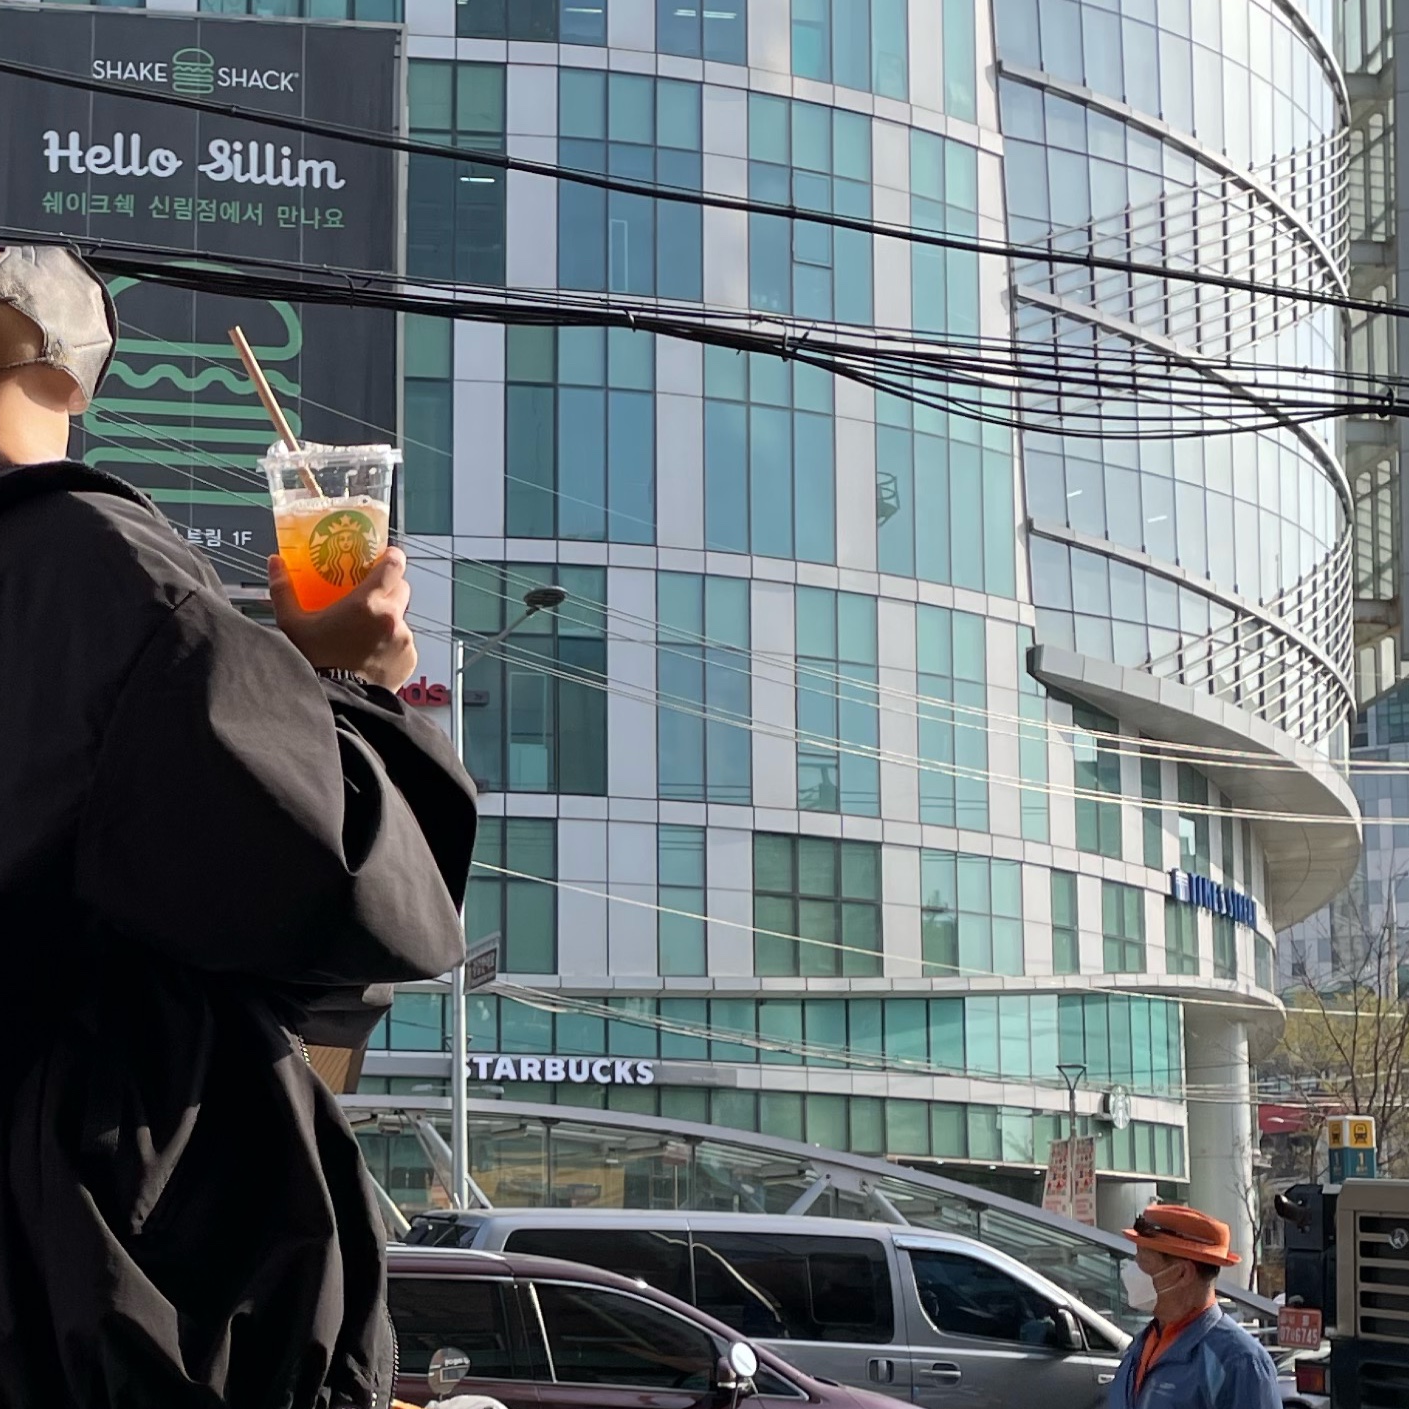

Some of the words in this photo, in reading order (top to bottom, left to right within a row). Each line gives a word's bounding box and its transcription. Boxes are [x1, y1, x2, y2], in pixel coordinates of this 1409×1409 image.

[92, 60, 168, 83] SHAKE
[217, 67, 294, 92] SHACK
[43, 130, 183, 177] Hello
[198, 139, 346, 190] Sillim
[42, 190, 135, 218] 쉐이크쉑
[148, 194, 264, 227] 신림점에서
[277, 204, 345, 230] 만나요
[173, 528, 221, 547] 트림
[233, 530, 252, 546] 1F
[466, 1056, 655, 1085] TARBUCKS
